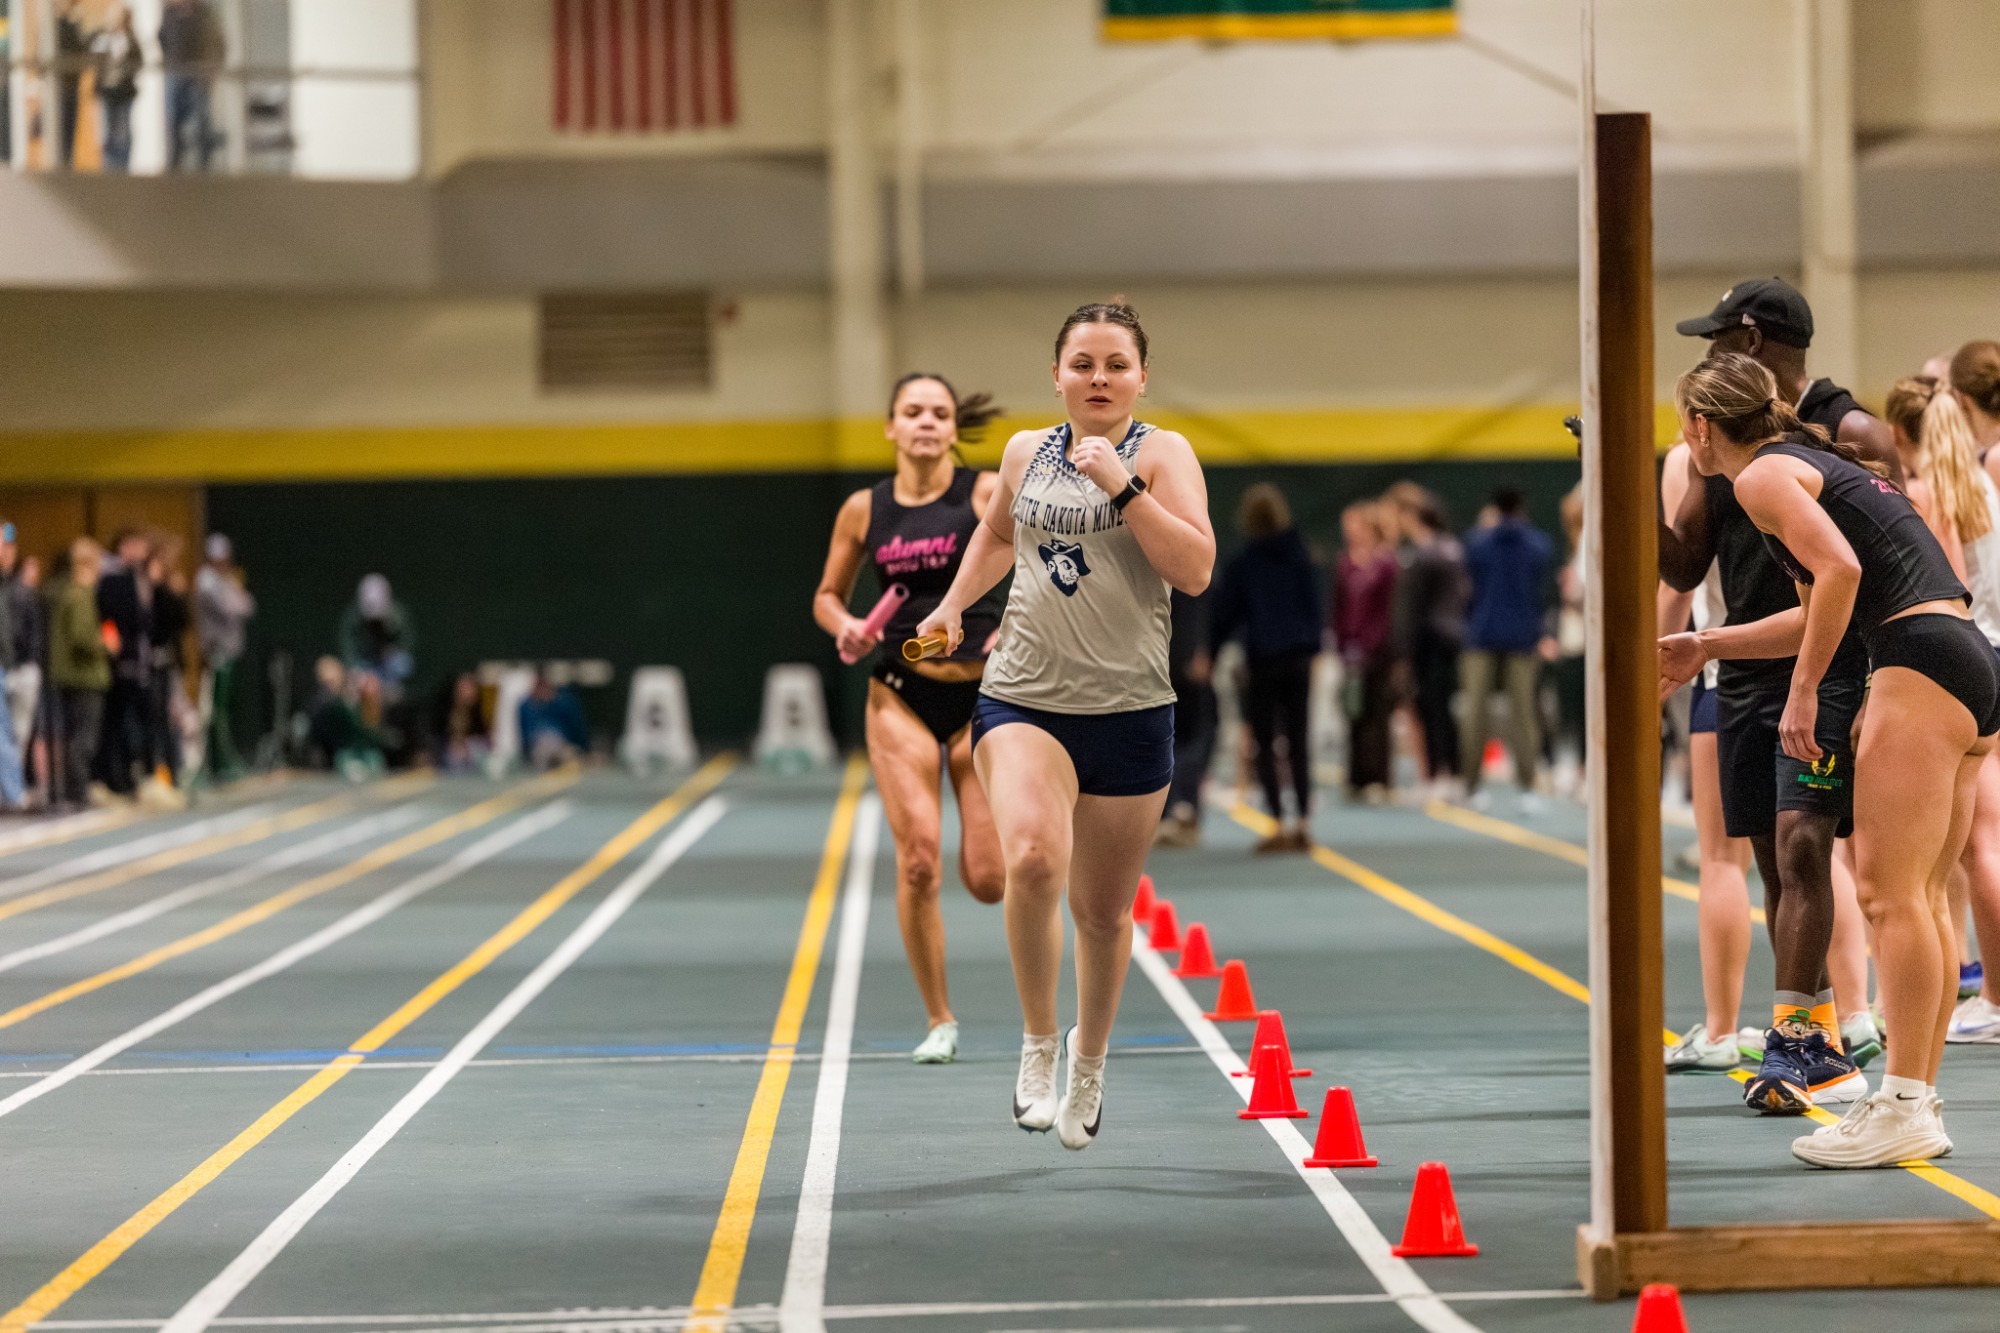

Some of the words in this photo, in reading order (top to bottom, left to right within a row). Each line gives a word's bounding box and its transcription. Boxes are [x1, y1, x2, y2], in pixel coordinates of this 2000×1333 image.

[1042, 504, 1087, 535] DAKOTA
[1093, 502, 1127, 533] MINE
[876, 532, 956, 563] alumni
